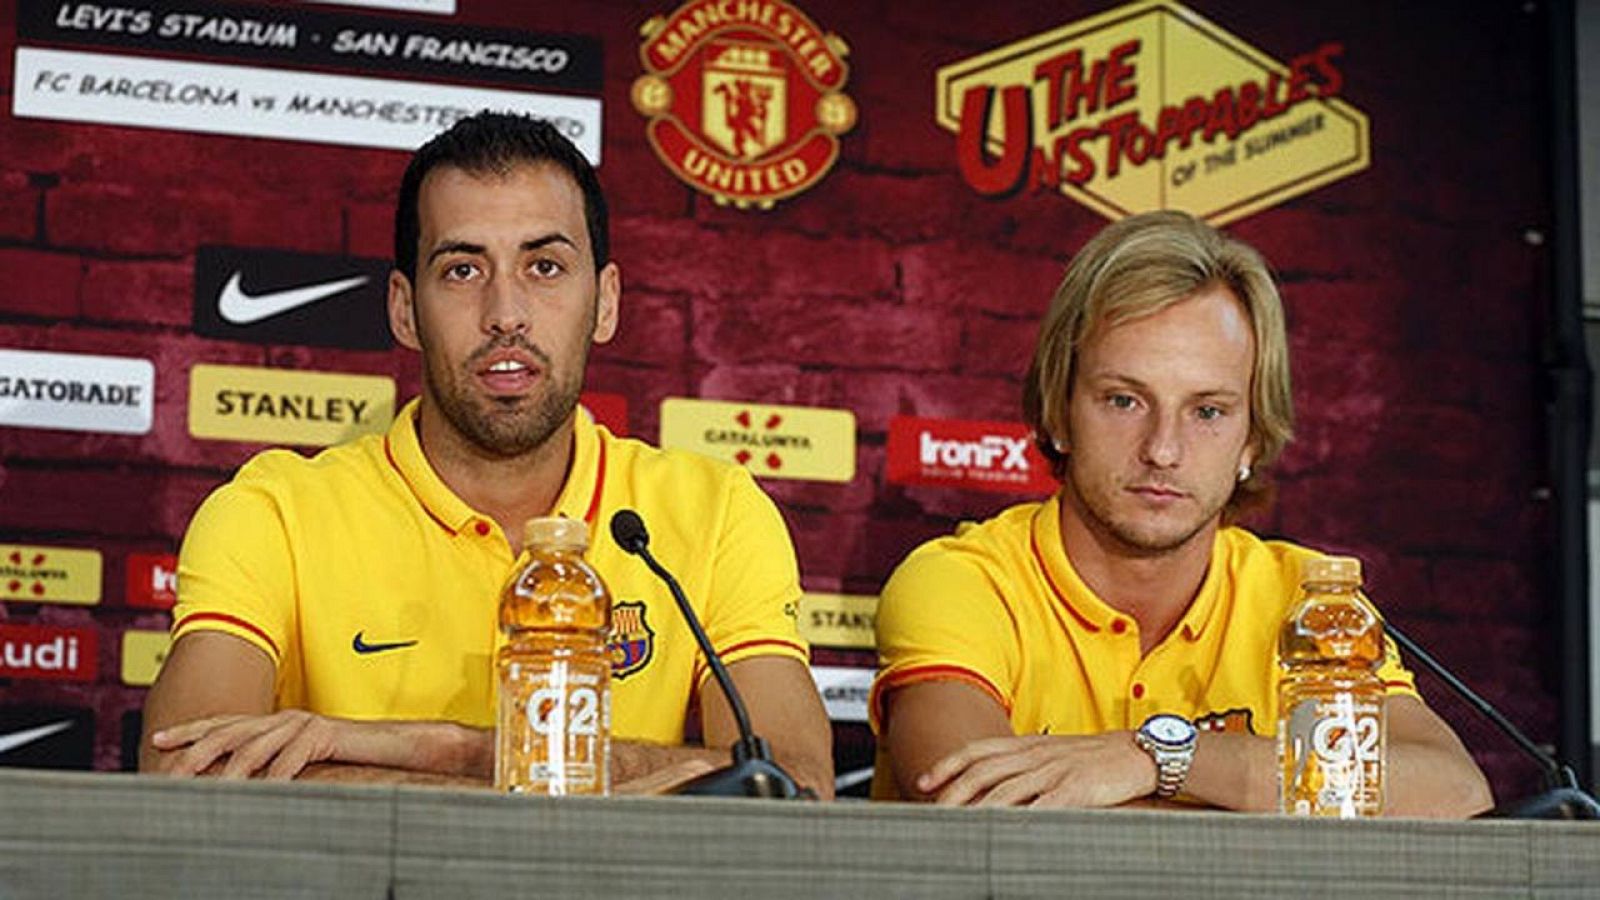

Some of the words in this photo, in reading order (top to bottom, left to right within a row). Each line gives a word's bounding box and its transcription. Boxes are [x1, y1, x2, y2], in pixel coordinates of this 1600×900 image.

[56, 4, 151, 32] LEVI'S
[159, 14, 297, 47] STADIUM
[332, 29, 398, 56] SAN
[402, 34, 568, 72] FRANCISCO
[657, 0, 832, 77] MANCHESTER
[34, 71, 70, 92] FC
[79, 75, 238, 106] BARCELONA
[1034, 38, 1141, 133] THE
[957, 42, 1345, 200] UNSTOPPABLES
[683, 150, 807, 191] UNITED
[216, 389, 368, 424] STANLEY
[919, 431, 1029, 470] IronFX
[0, 636, 78, 671] udi
